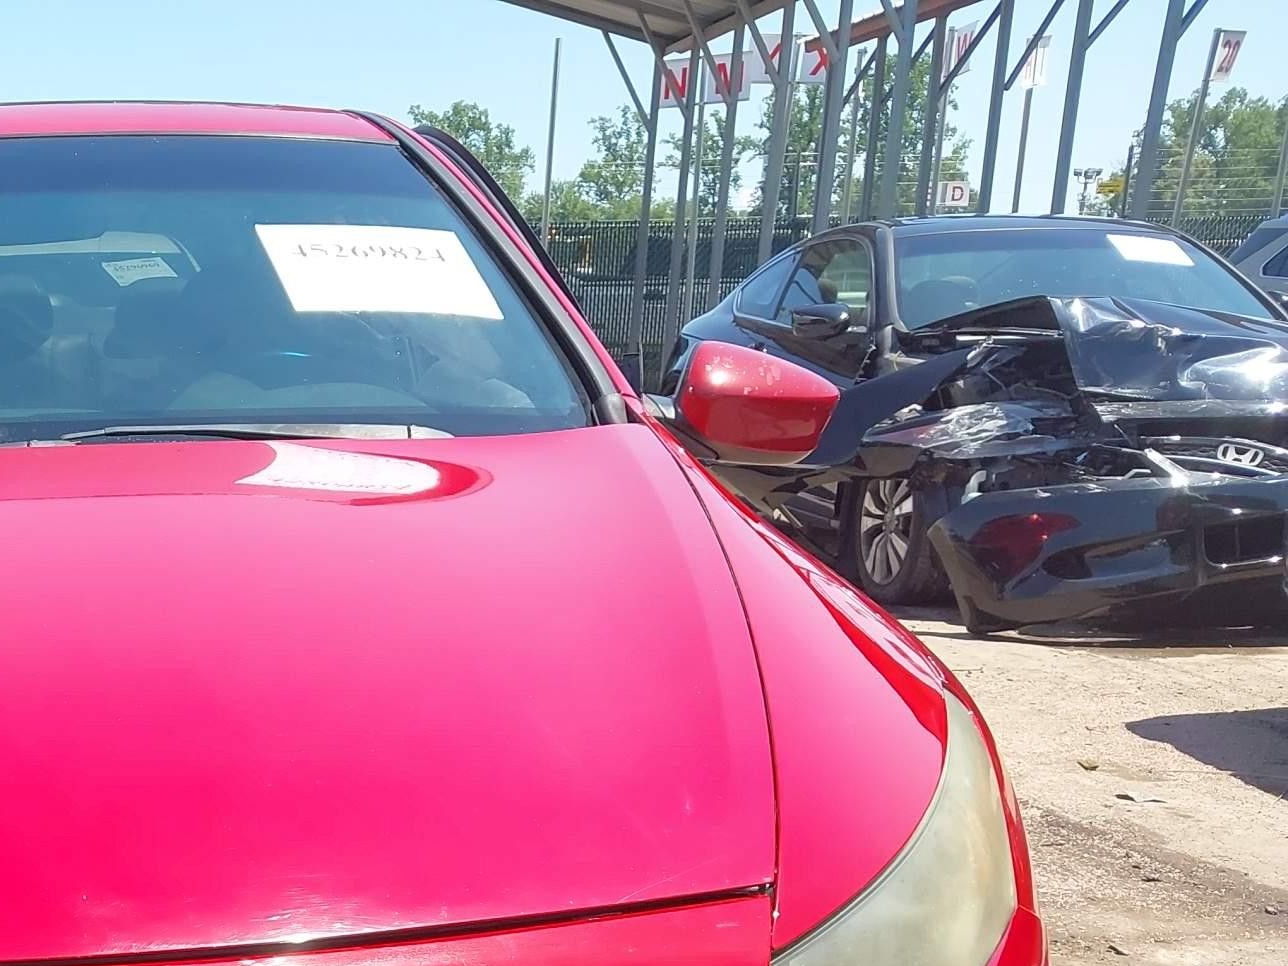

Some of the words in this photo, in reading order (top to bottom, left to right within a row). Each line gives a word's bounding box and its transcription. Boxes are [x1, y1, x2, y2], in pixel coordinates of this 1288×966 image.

[1217, 39, 1241, 73] 20
[663, 66, 688, 100] N
[951, 185, 964, 202] D
